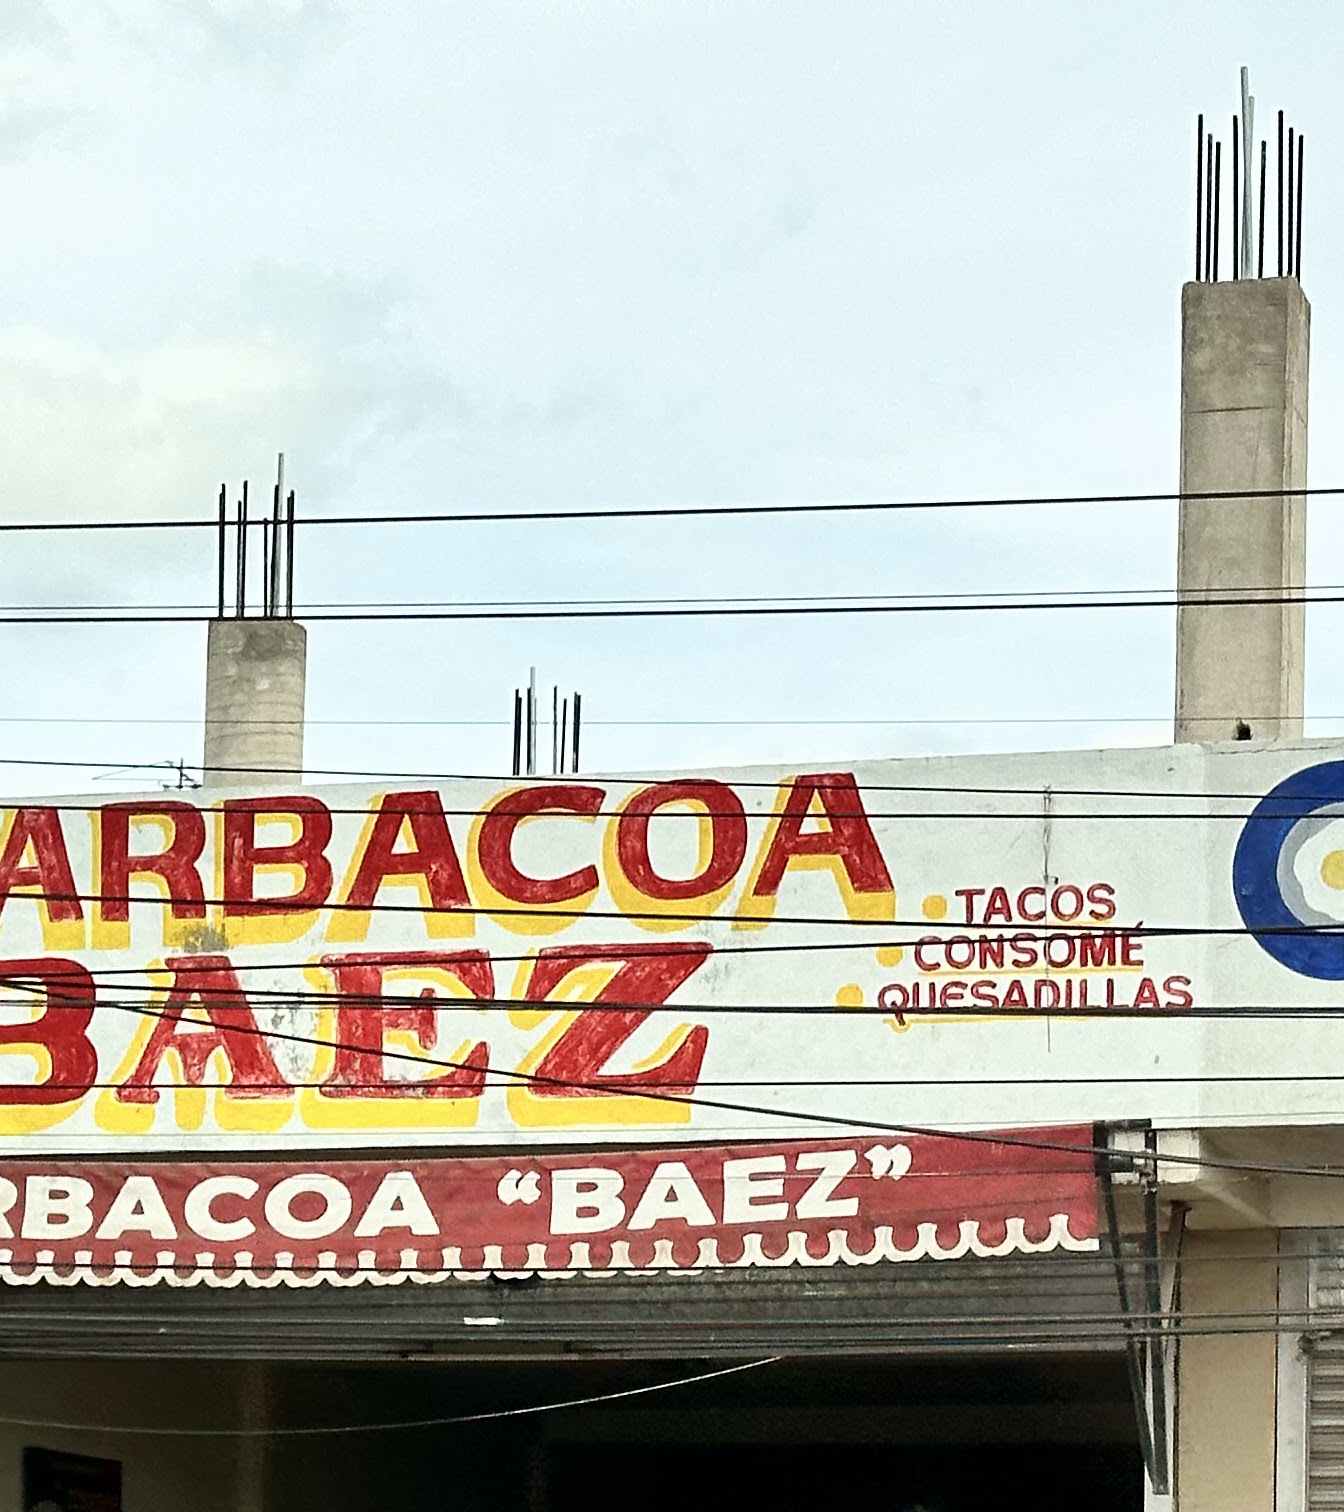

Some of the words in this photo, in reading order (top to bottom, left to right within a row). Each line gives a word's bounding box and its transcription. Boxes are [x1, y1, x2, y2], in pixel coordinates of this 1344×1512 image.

[955, 883, 1117, 924] TACOS
[914, 921, 1144, 971] CONSOMÉ
[877, 976, 1194, 1026] QUESADILLAS
